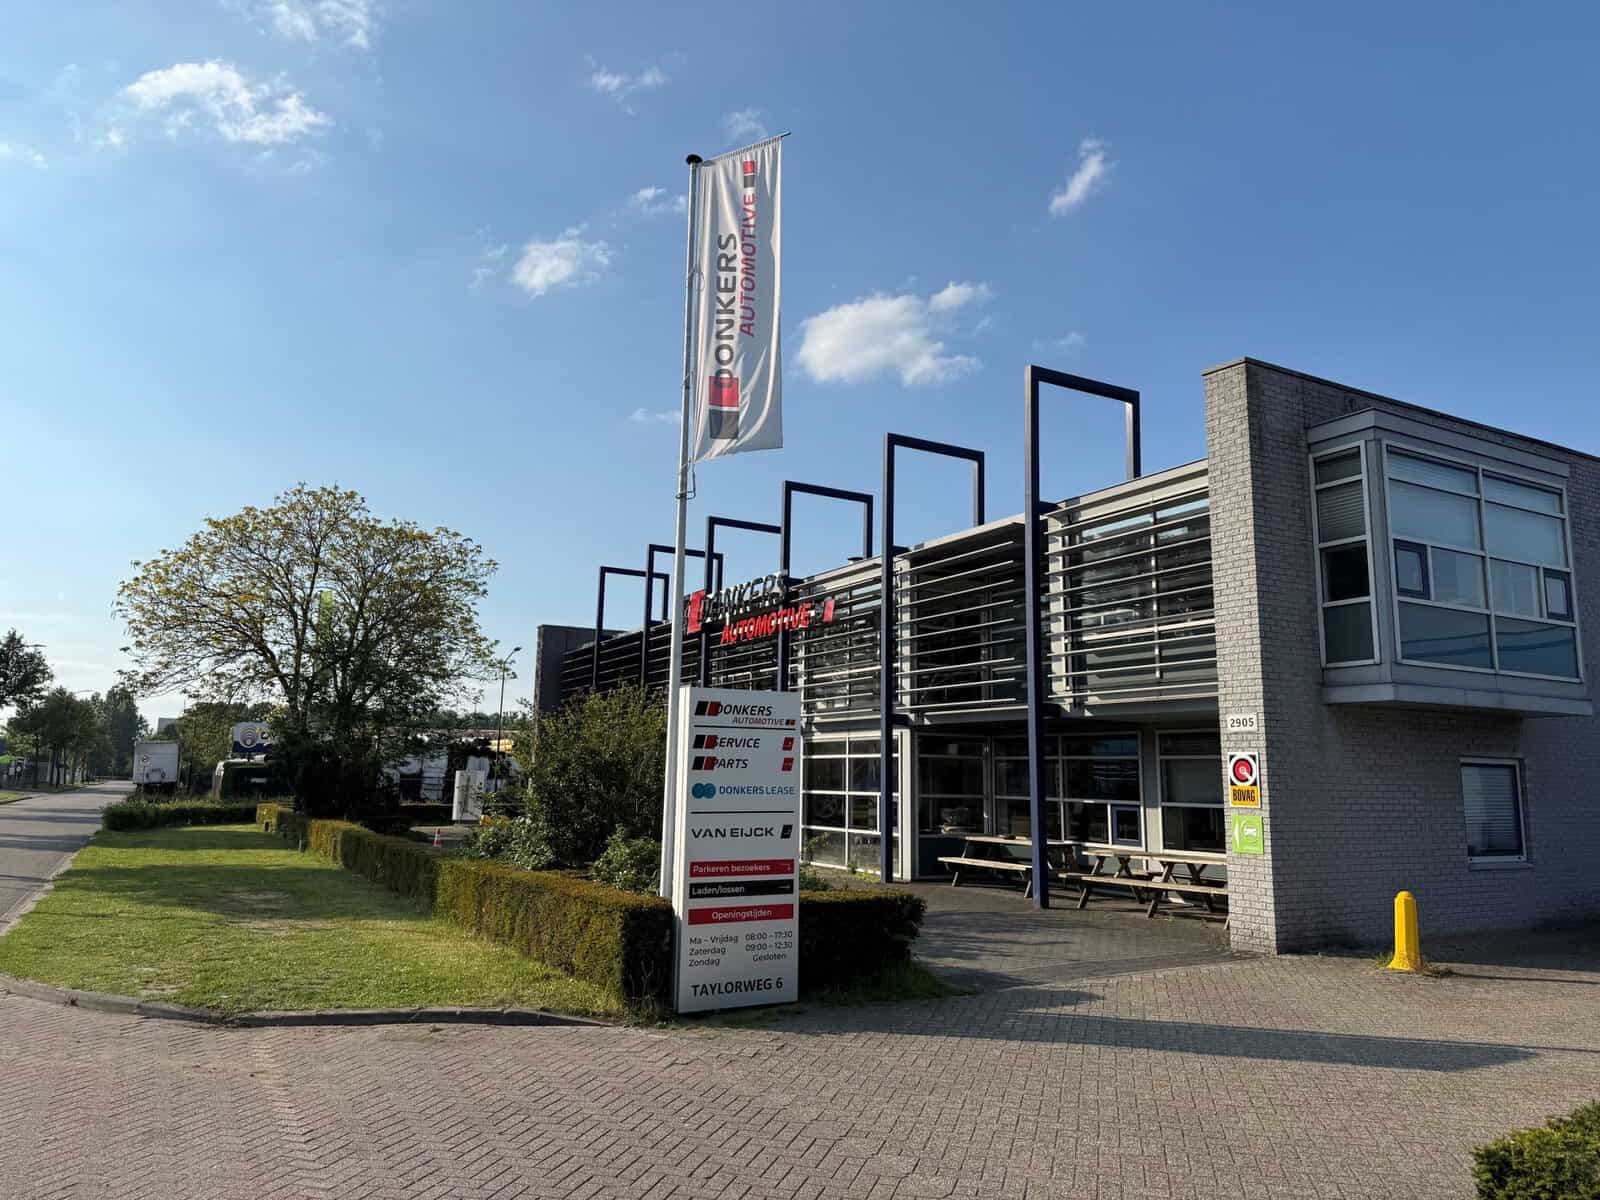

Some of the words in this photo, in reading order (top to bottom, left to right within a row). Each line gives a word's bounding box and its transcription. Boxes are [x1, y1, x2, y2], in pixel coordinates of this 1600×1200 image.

[739, 193, 756, 337] AUTOMOTIVE
[714, 233, 738, 389] DONKERS
[720, 602, 812, 644] AUTOMOTIVE
[717, 704, 773, 716] DONKERS
[732, 717, 785, 726] AUTOMOTIVE
[1230, 717, 1255, 728] 2905
[714, 737, 760, 748] SERVICE
[713, 759, 748, 769] PARTS
[1233, 788, 1256, 802] BOVAG
[692, 828, 726, 838] VAN
[730, 827, 774, 838] EIJCK
[693, 863, 730, 873] Parkeren
[731, 863, 770, 872] bezoekers
[692, 885, 745, 895] Laden/lossen
[711, 910, 772, 920] Openingstijden
[689, 936, 702, 945] Ma
[710, 935, 739, 945] Vrijdag
[745, 933, 767, 941] 08:00
[774, 931, 793, 939] 17:30
[688, 946, 726, 956] Zaterdag
[745, 943, 767, 952] 09:00
[774, 941, 793, 949] 12:30
[688, 958, 720, 967] Zondag
[752, 952, 786, 962] Gesloten
[691, 977, 773, 997] TAYLORWEG
[775, 976, 784, 990] 6
